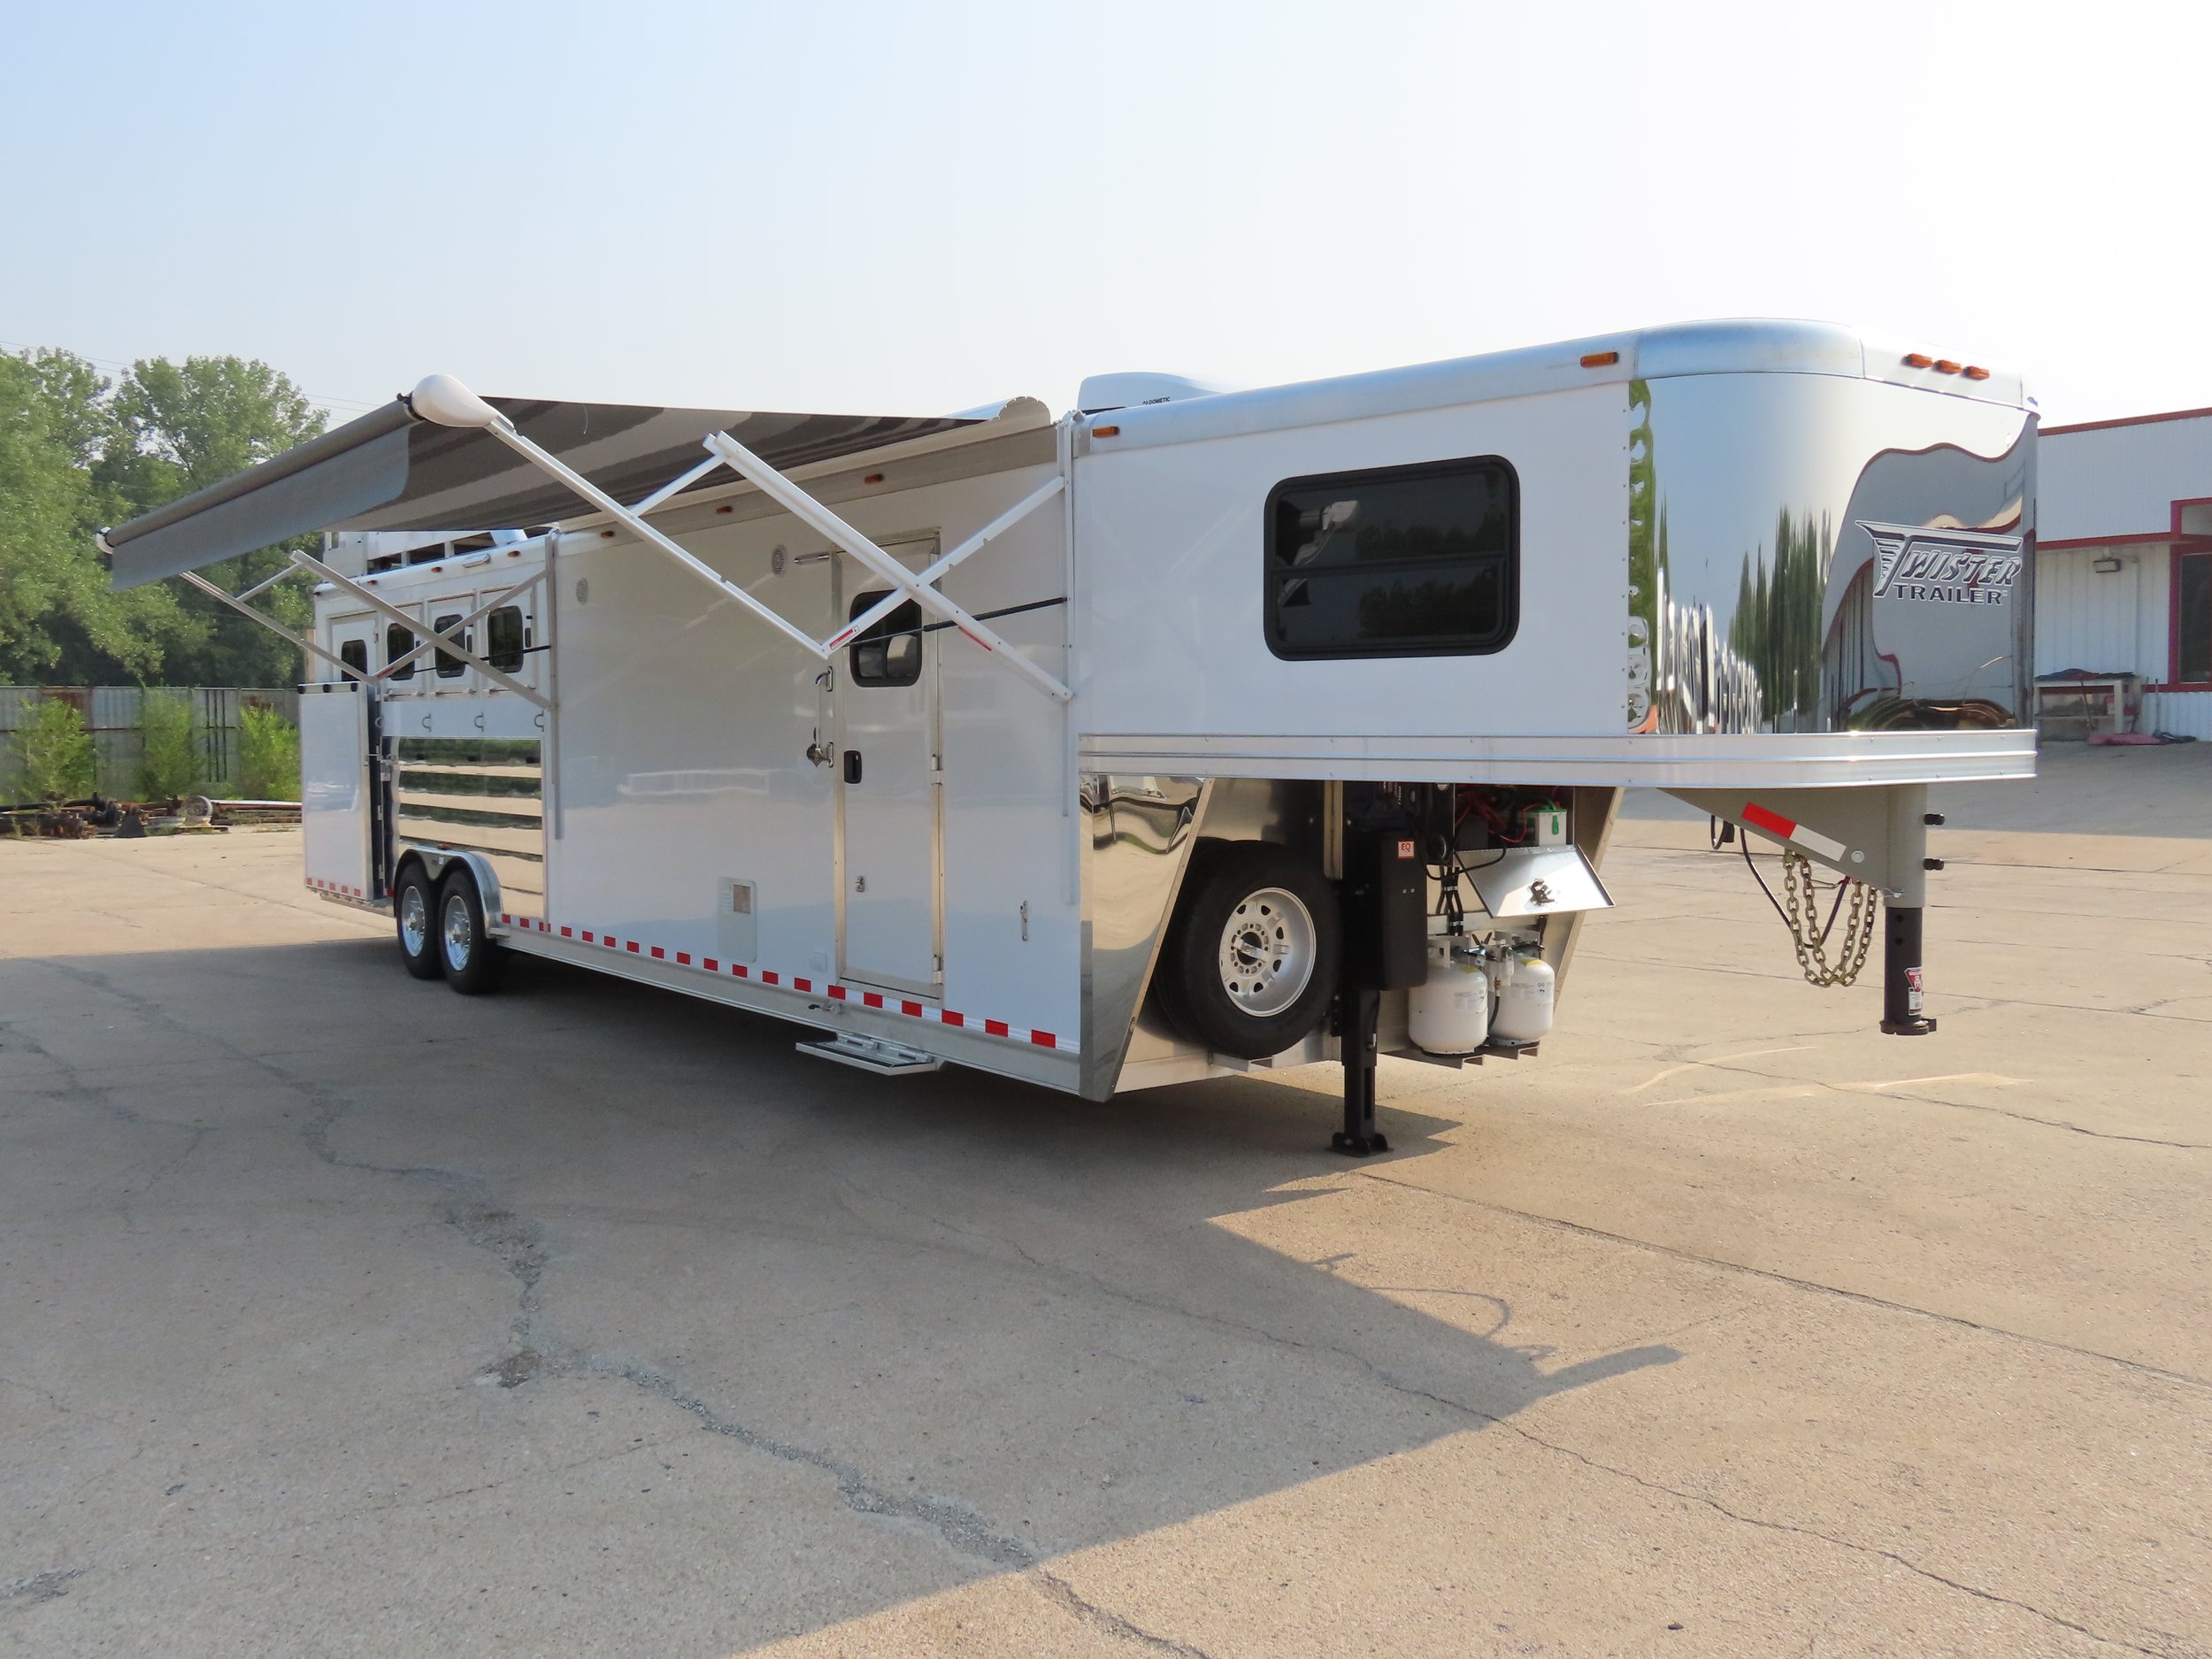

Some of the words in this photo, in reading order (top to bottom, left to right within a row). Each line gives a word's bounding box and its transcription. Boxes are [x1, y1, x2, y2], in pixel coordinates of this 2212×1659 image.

[1855, 519, 2024, 598] TWISTER
[1893, 581, 2003, 605] TRAILER
[1401, 842, 1411, 852] EQ
